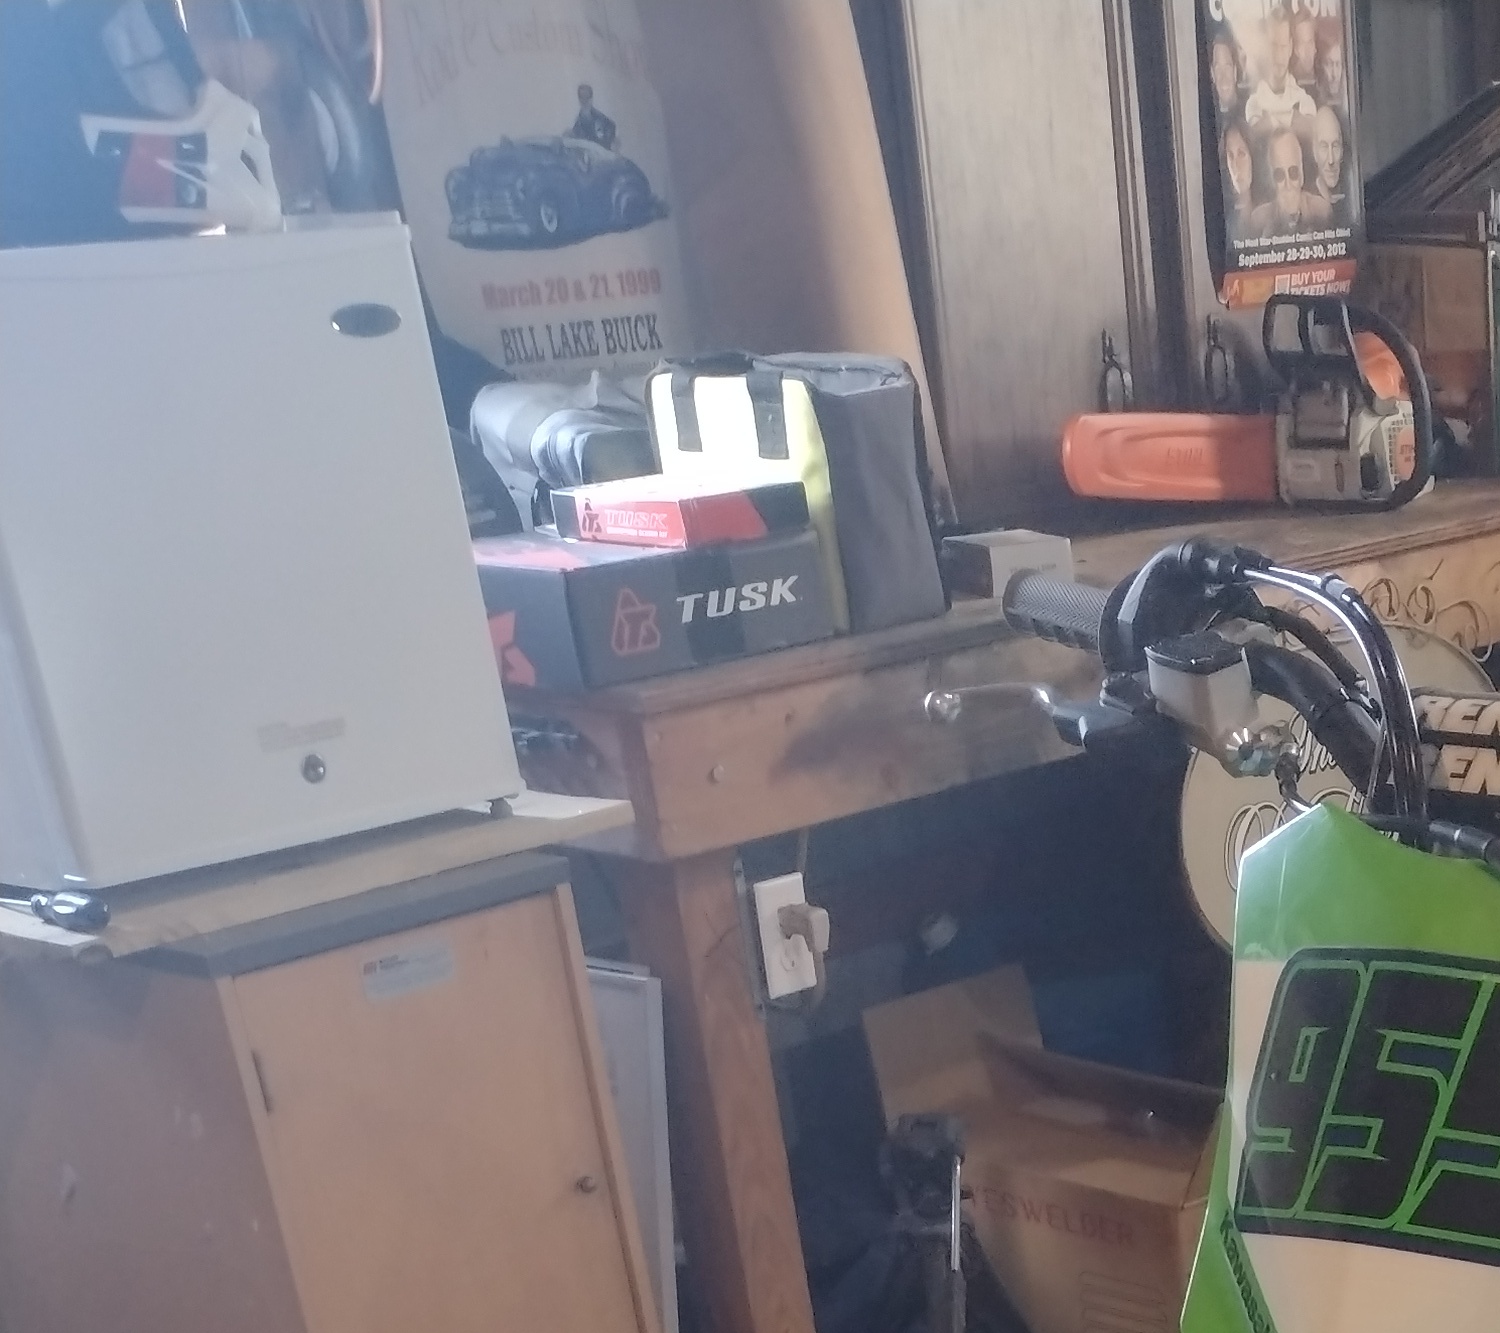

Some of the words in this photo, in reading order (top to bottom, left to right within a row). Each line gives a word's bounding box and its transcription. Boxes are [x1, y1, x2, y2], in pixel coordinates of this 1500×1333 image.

[1238, 250, 1285, 268] September
[1327, 242, 1347, 258] 2012
[482, 279, 541, 310] March
[545, 275, 570, 305] 20
[573, 278, 586, 302] &
[617, 267, 662, 298] 1999
[1290, 271, 1310, 287] BUY
[1312, 268, 1337, 284] YOUR
[1290, 282, 1326, 296] TICKETS
[500, 325, 546, 366] BILL
[545, 319, 600, 360] LAKE
[601, 313, 664, 355] BUICK
[604, 508, 668, 529] TUSK
[676, 575, 799, 624] TUSK
